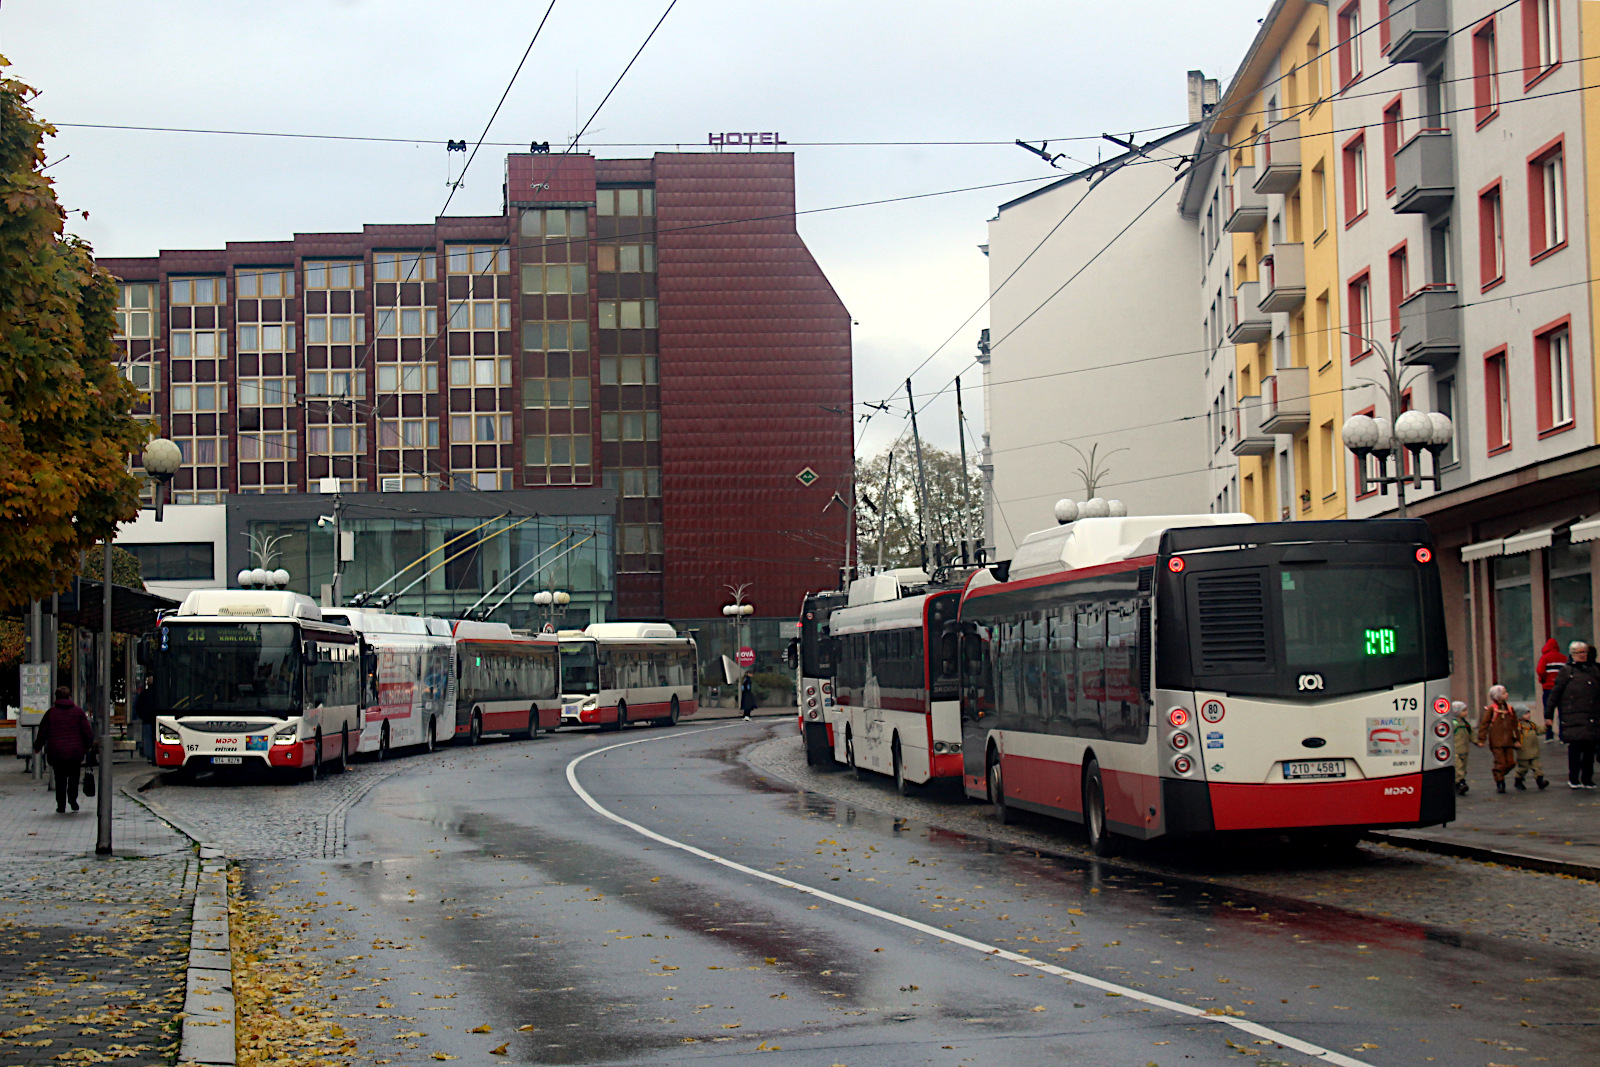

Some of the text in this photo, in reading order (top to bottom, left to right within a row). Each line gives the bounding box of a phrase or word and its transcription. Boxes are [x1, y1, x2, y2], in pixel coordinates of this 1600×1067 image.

[709, 132, 787, 145] HOTEL
[187, 628, 205, 640] 213
[1208, 704, 1218, 714] 80
[1392, 698, 1418, 711] 179
[207, 721, 247, 731] IVECO
[187, 744, 199, 752] 167
[1292, 762, 1340, 774] 2TD 4581
[1384, 786, 1415, 796] MDPO
